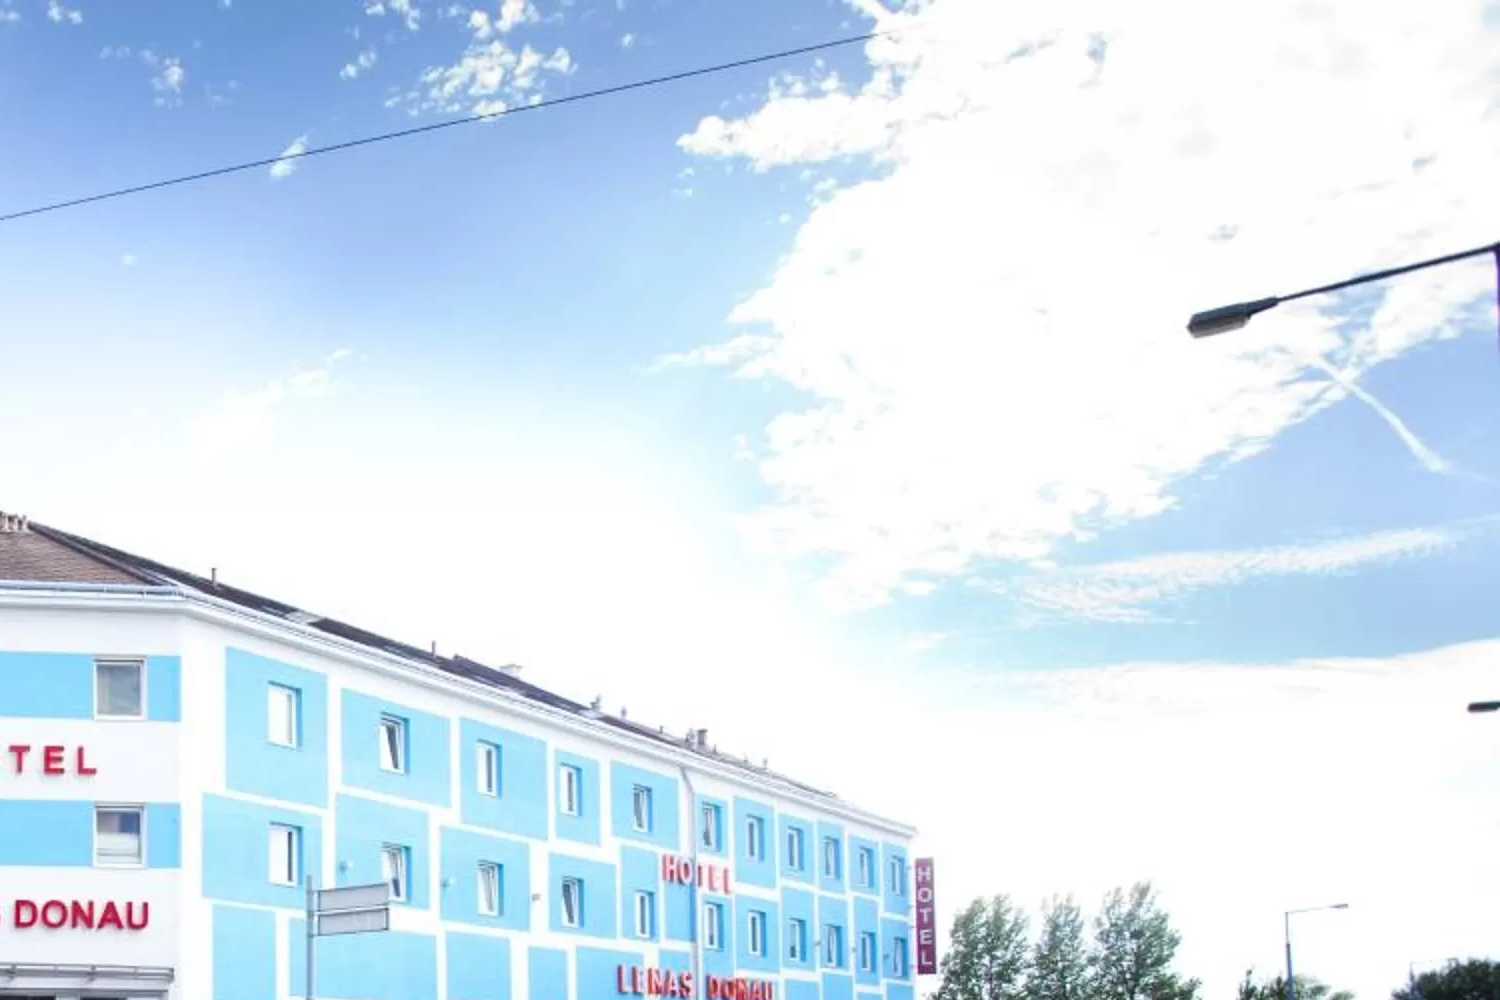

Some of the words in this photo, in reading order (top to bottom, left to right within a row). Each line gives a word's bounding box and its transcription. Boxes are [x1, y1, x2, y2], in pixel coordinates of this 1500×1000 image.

[662, 854, 730, 895] HOTEL
[13, 899, 149, 930] DONAU
[917, 867, 933, 965] HOTEL
[617, 964, 693, 1000] LENAS
